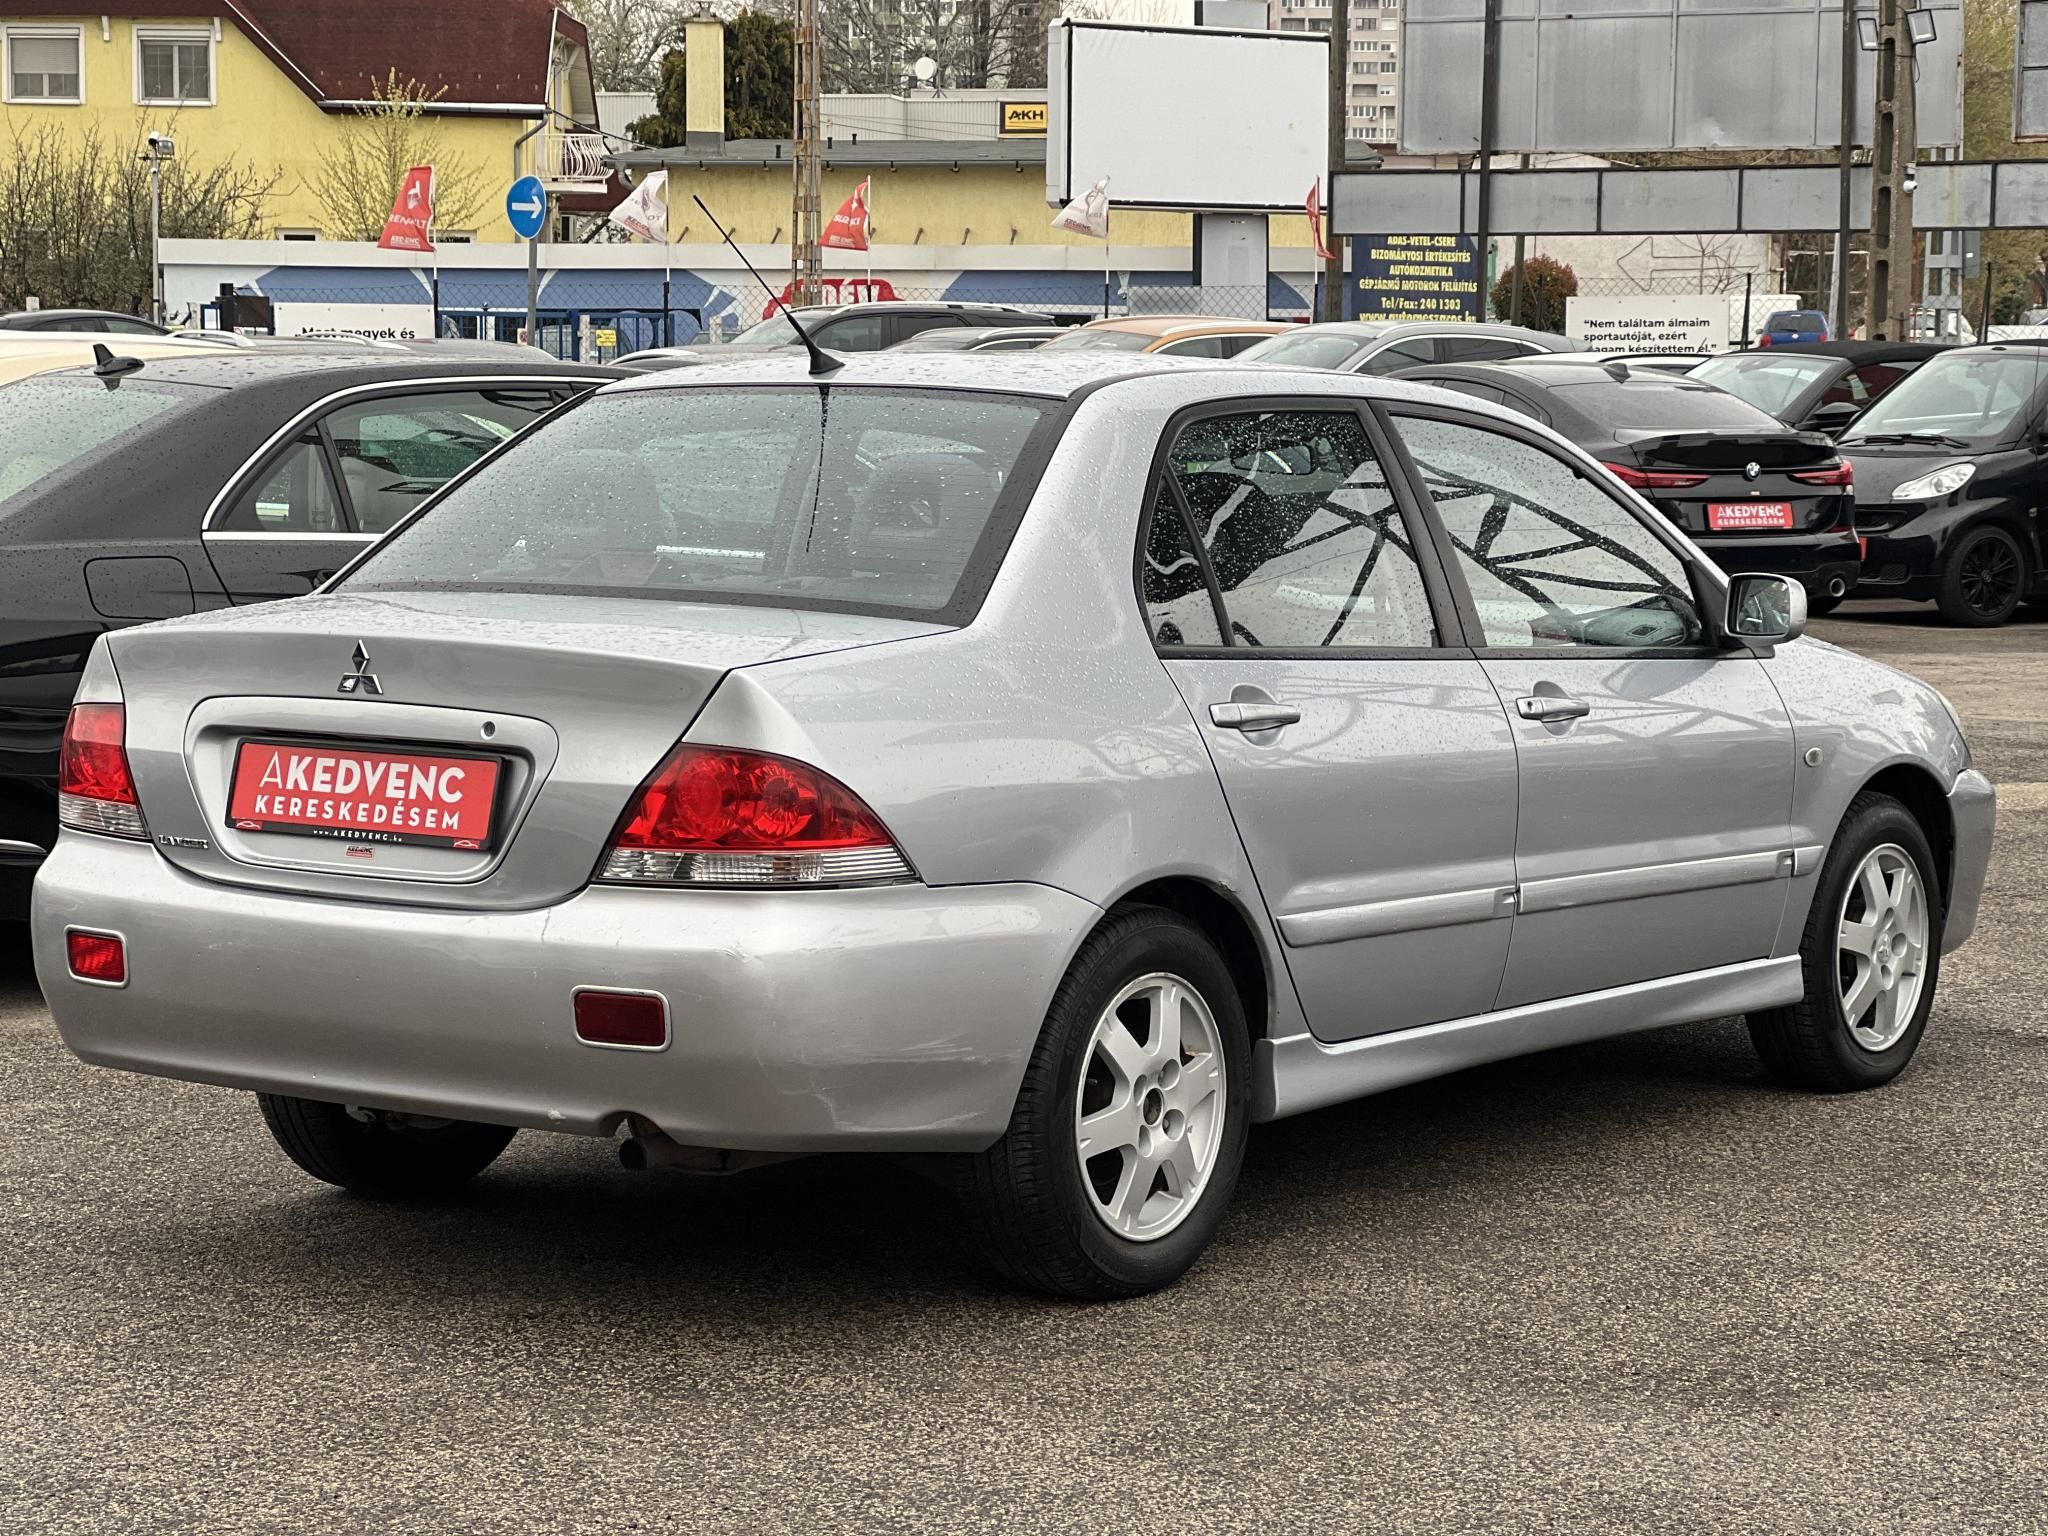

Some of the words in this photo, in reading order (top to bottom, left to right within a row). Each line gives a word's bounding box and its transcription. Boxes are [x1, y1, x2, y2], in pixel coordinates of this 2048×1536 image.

[1007, 110, 1044, 120] AKH
[1371, 248, 1423, 261] BIZOMÁNYOSI
[1425, 249, 1471, 262] ÉRTÉKESÍTÉS
[1389, 263, 1453, 277] AUTÓKOZMETIKA
[1402, 280, 1439, 291] MOTOROK
[1381, 297, 1418, 310] Tel/Fax:
[1420, 298, 1437, 309] 240
[1439, 299, 1461, 310] 1303
[1618, 318, 1665, 328] találtam
[1668, 317, 1710, 328] álmaim
[400, 327, 416, 339] és
[1583, 331, 1656, 343] sportautóját,
[1658, 331, 1688, 341] ezért
[1717, 505, 1785, 517] AKEDVENC
[1717, 516, 1785, 526] KERESKEDÉSEM
[259, 751, 467, 804] AKEDVENC
[254, 794, 461, 830] KERESKEDÉSEM
